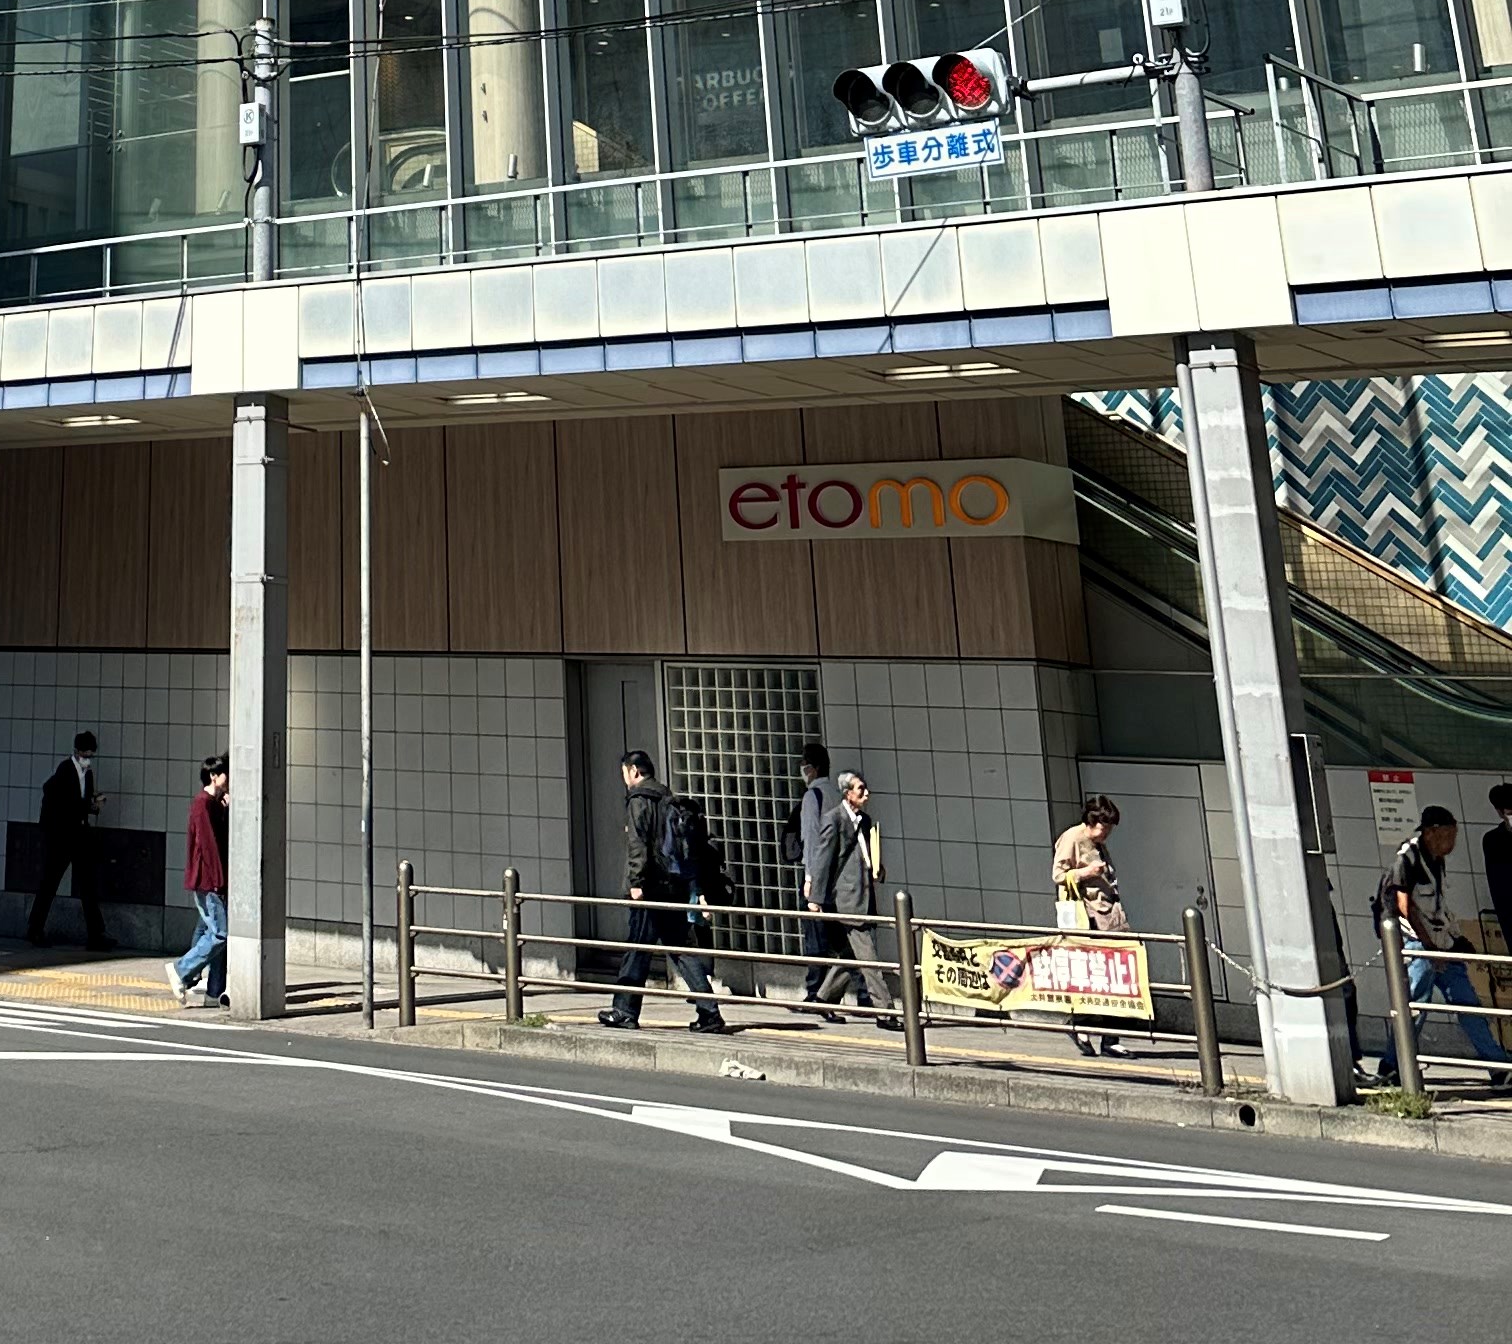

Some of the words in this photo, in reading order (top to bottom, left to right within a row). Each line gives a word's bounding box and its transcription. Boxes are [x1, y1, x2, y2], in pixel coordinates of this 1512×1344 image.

[677, 66, 763, 90] ARBUC
[697, 88, 765, 112] OFFE
[872, 128, 996, 171] 歩車分離式
[728, 474, 1009, 530] etomo
[934, 964, 990, 991] その周辺は
